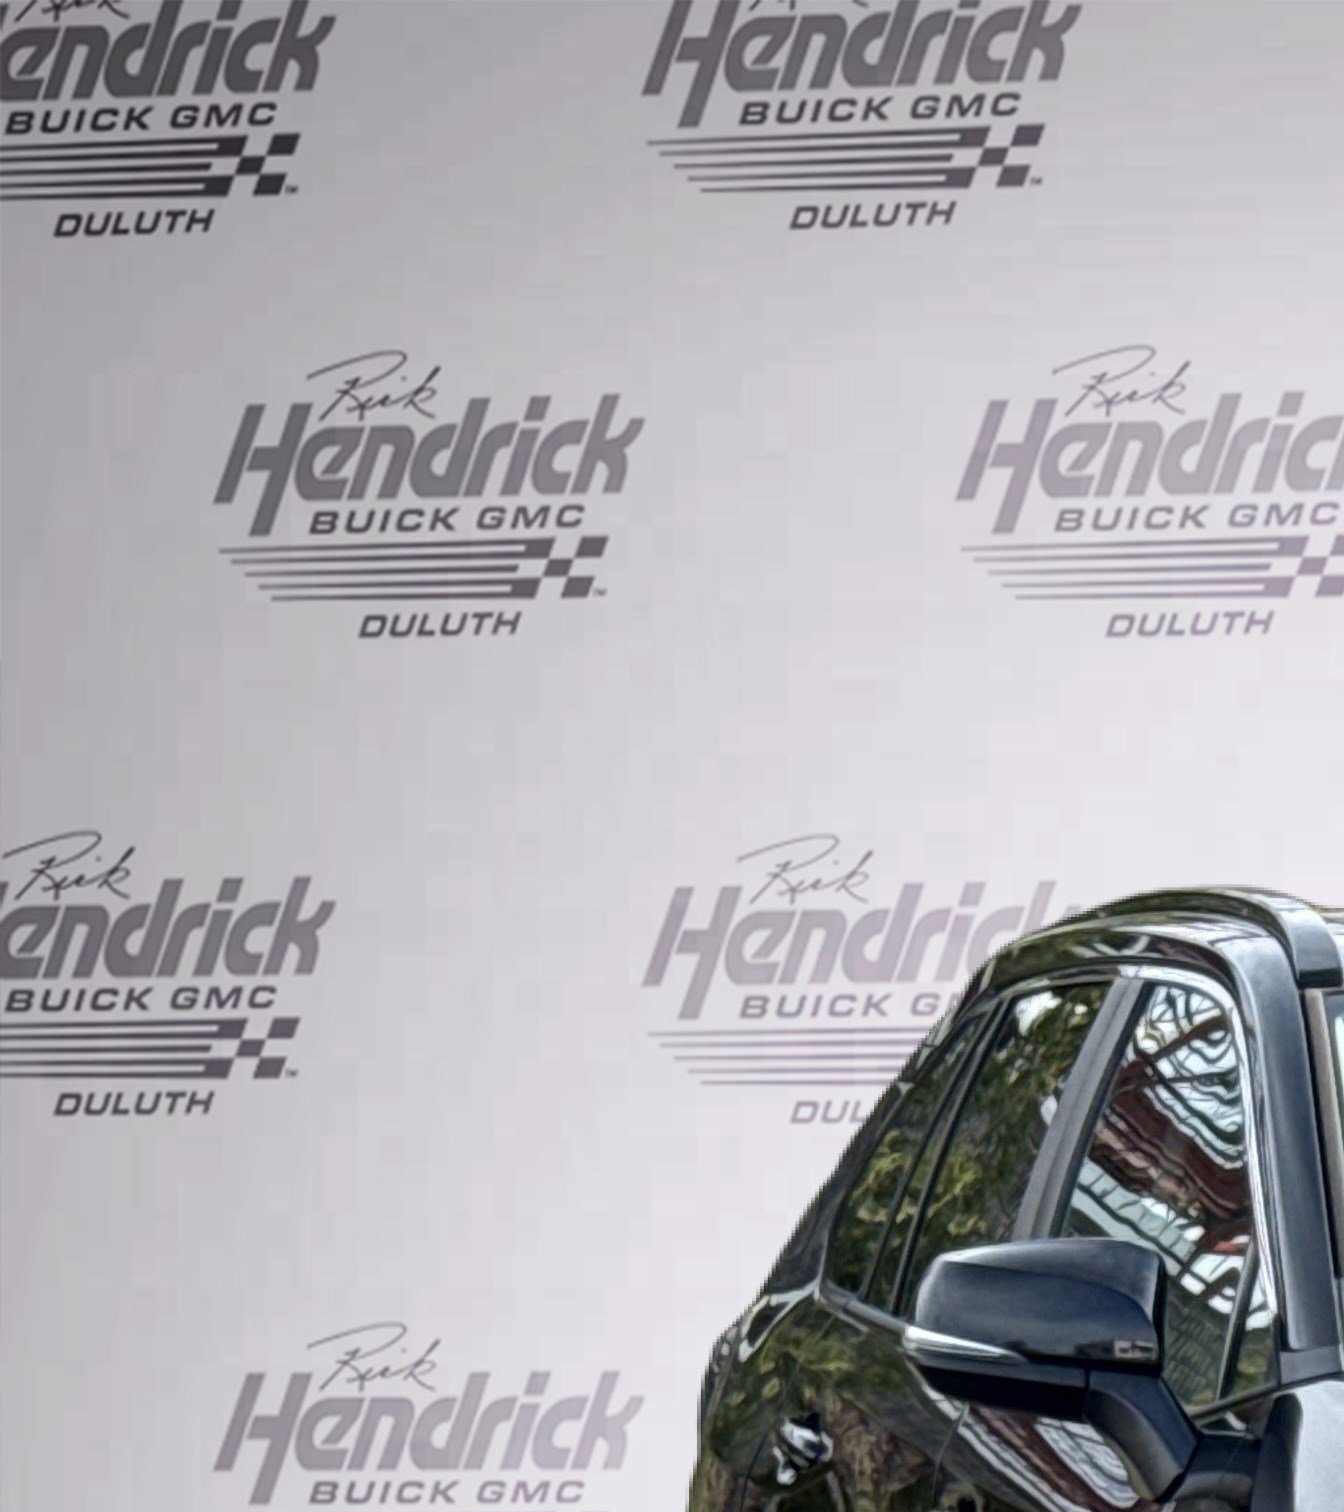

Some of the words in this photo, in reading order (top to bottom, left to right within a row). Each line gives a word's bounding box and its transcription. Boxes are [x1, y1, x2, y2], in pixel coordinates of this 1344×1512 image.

[0, 0, 337, 101] endrick
[641, 0, 1083, 128] Hendrick
[5, 106, 154, 135] BUICK
[169, 102, 278, 129] GMC
[738, 97, 893, 125] BUICK
[910, 93, 1022, 119] GMC
[53, 209, 215, 238] DULUTH
[789, 201, 957, 229] DULUTH
[213, 393, 645, 537] Hendrick
[308, 507, 460, 535] BUICK
[476, 504, 586, 530] GMC
[1054, 505, 1210, 532] BUICK
[1227, 502, 1341, 528] GMC
[357, 611, 522, 639] DULUTH
[1105, 610, 1274, 638] DULUTH
[0, 876, 337, 980] endrick
[4, 987, 154, 1012] BUICK
[169, 985, 278, 1010] GMC
[739, 993, 892, 1020] BUICK
[53, 1091, 215, 1116] DULUTH
[789, 1100, 867, 1125] DUL
[213, 1370, 645, 1506] Hendrick
[308, 1481, 460, 1505] BUICK
[476, 1480, 586, 1504] GMC
